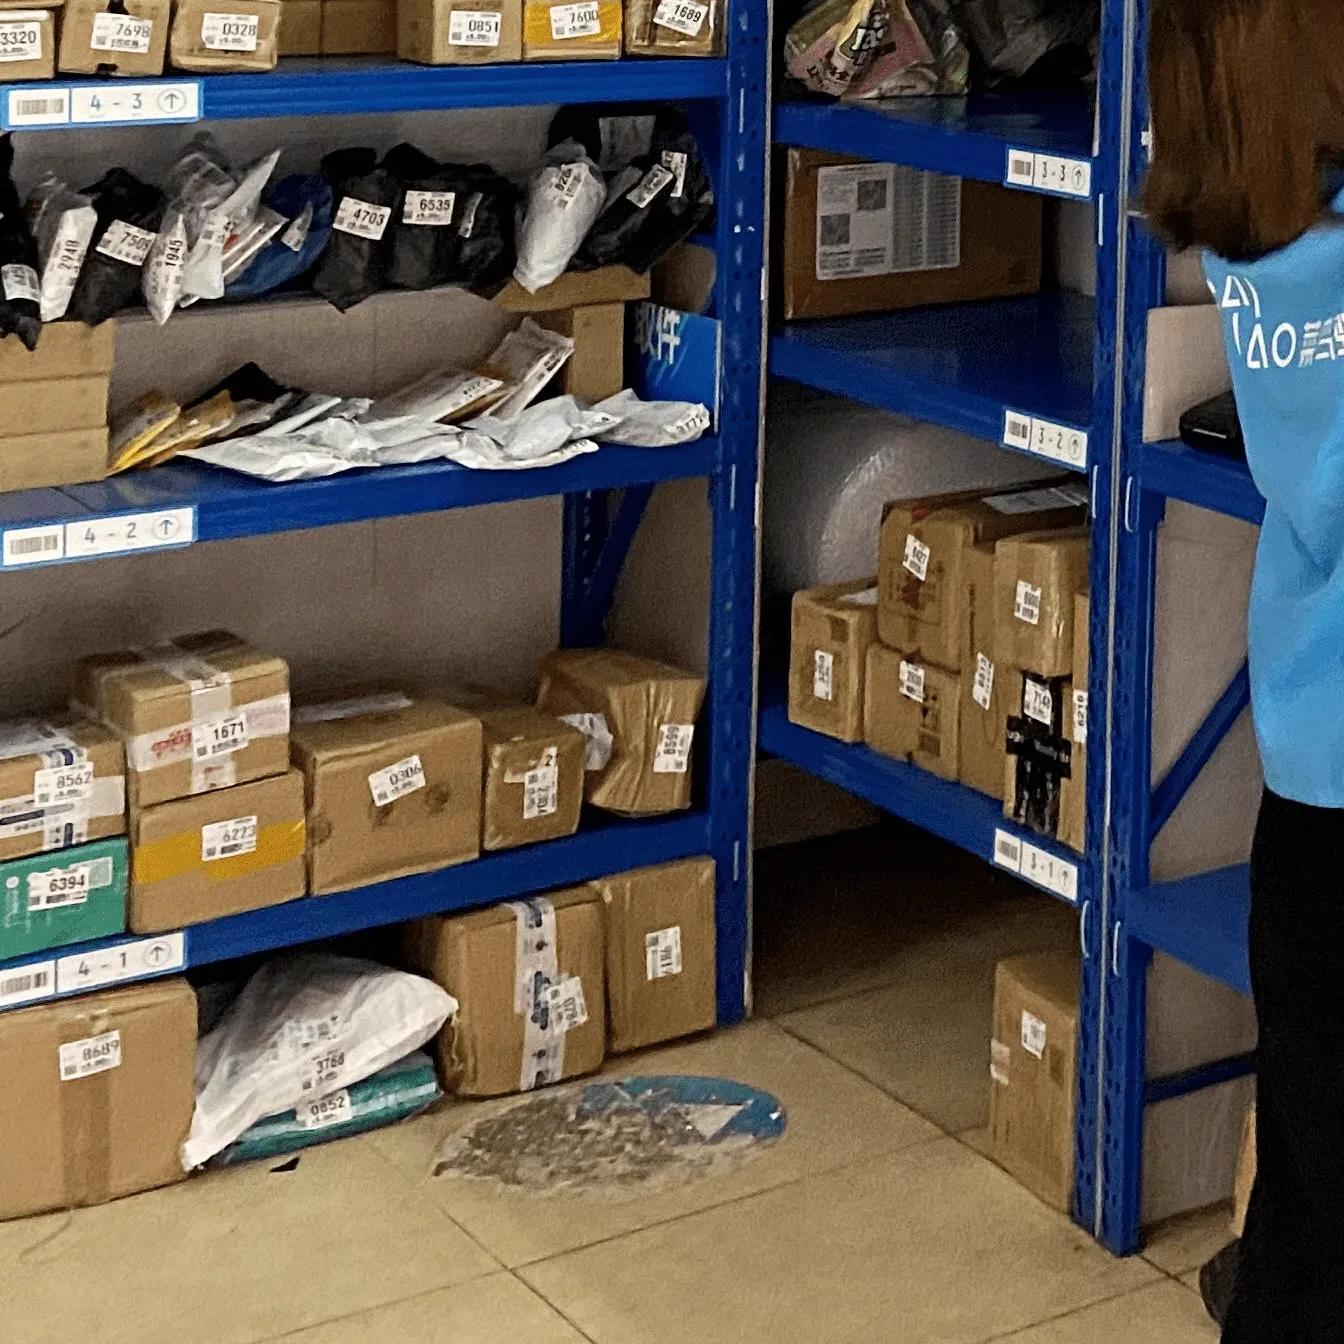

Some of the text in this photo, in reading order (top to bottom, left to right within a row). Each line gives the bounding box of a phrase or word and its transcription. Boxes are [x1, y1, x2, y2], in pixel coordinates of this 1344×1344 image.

[673, 4, 701, 22] 1689
[115, 23, 149, 38] 7698
[419, 197, 451, 212] 6535
[353, 208, 384, 228] 4703
[213, 720, 244, 742] 1671
[49, 875, 85, 893] 6394
